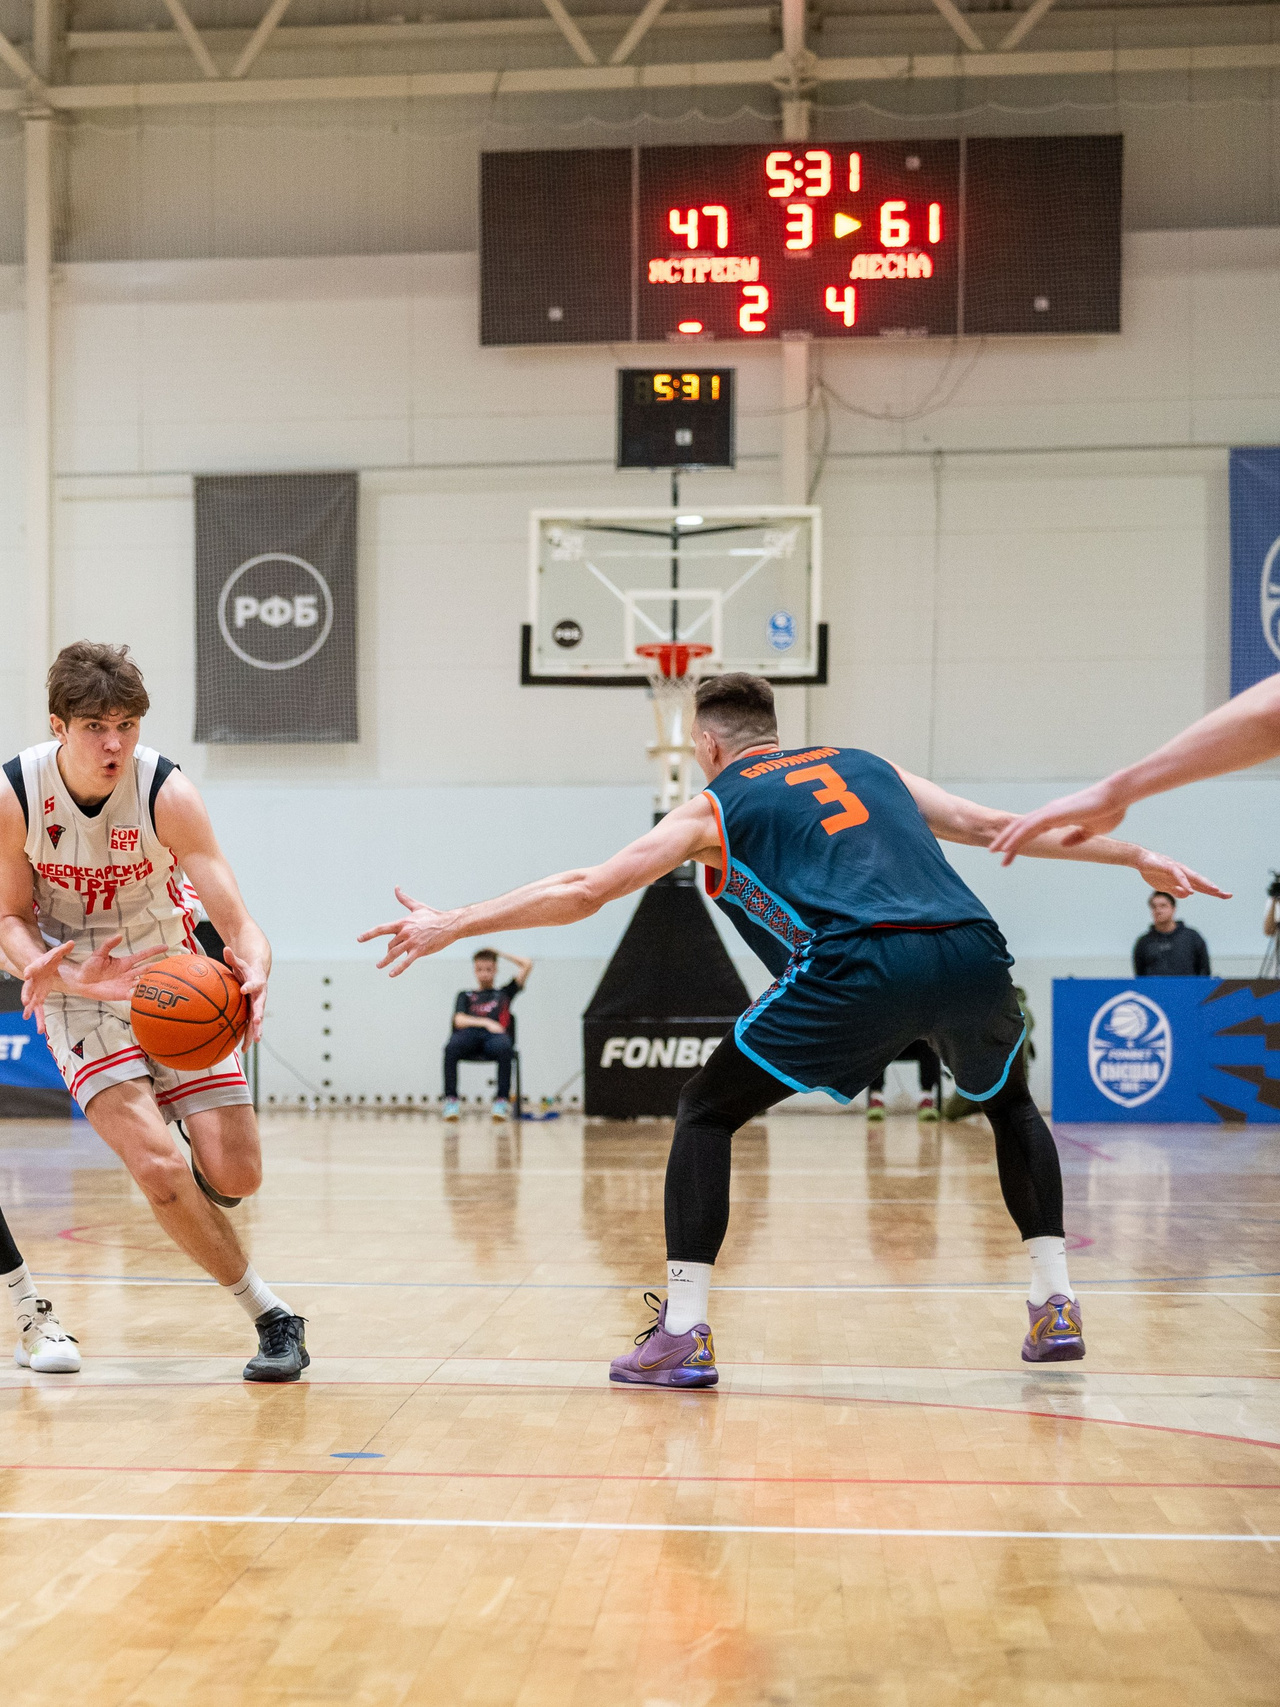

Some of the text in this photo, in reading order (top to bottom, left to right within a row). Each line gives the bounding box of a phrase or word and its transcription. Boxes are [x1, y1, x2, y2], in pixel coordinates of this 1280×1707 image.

[765, 150, 861, 198] 5:31
[669, 205, 729, 249] 47
[785, 203, 813, 250] 3
[880, 200, 941, 248] 61
[739, 285, 769, 332] 2
[825, 286, 856, 327] 4
[653, 373, 721, 401] 5:31
[234, 595, 319, 628] РФБ
[785, 763, 869, 836] 3
[110, 839, 138, 851] BET
[111, 828, 139, 841] FON
[600, 1036, 724, 1068] FONBE
